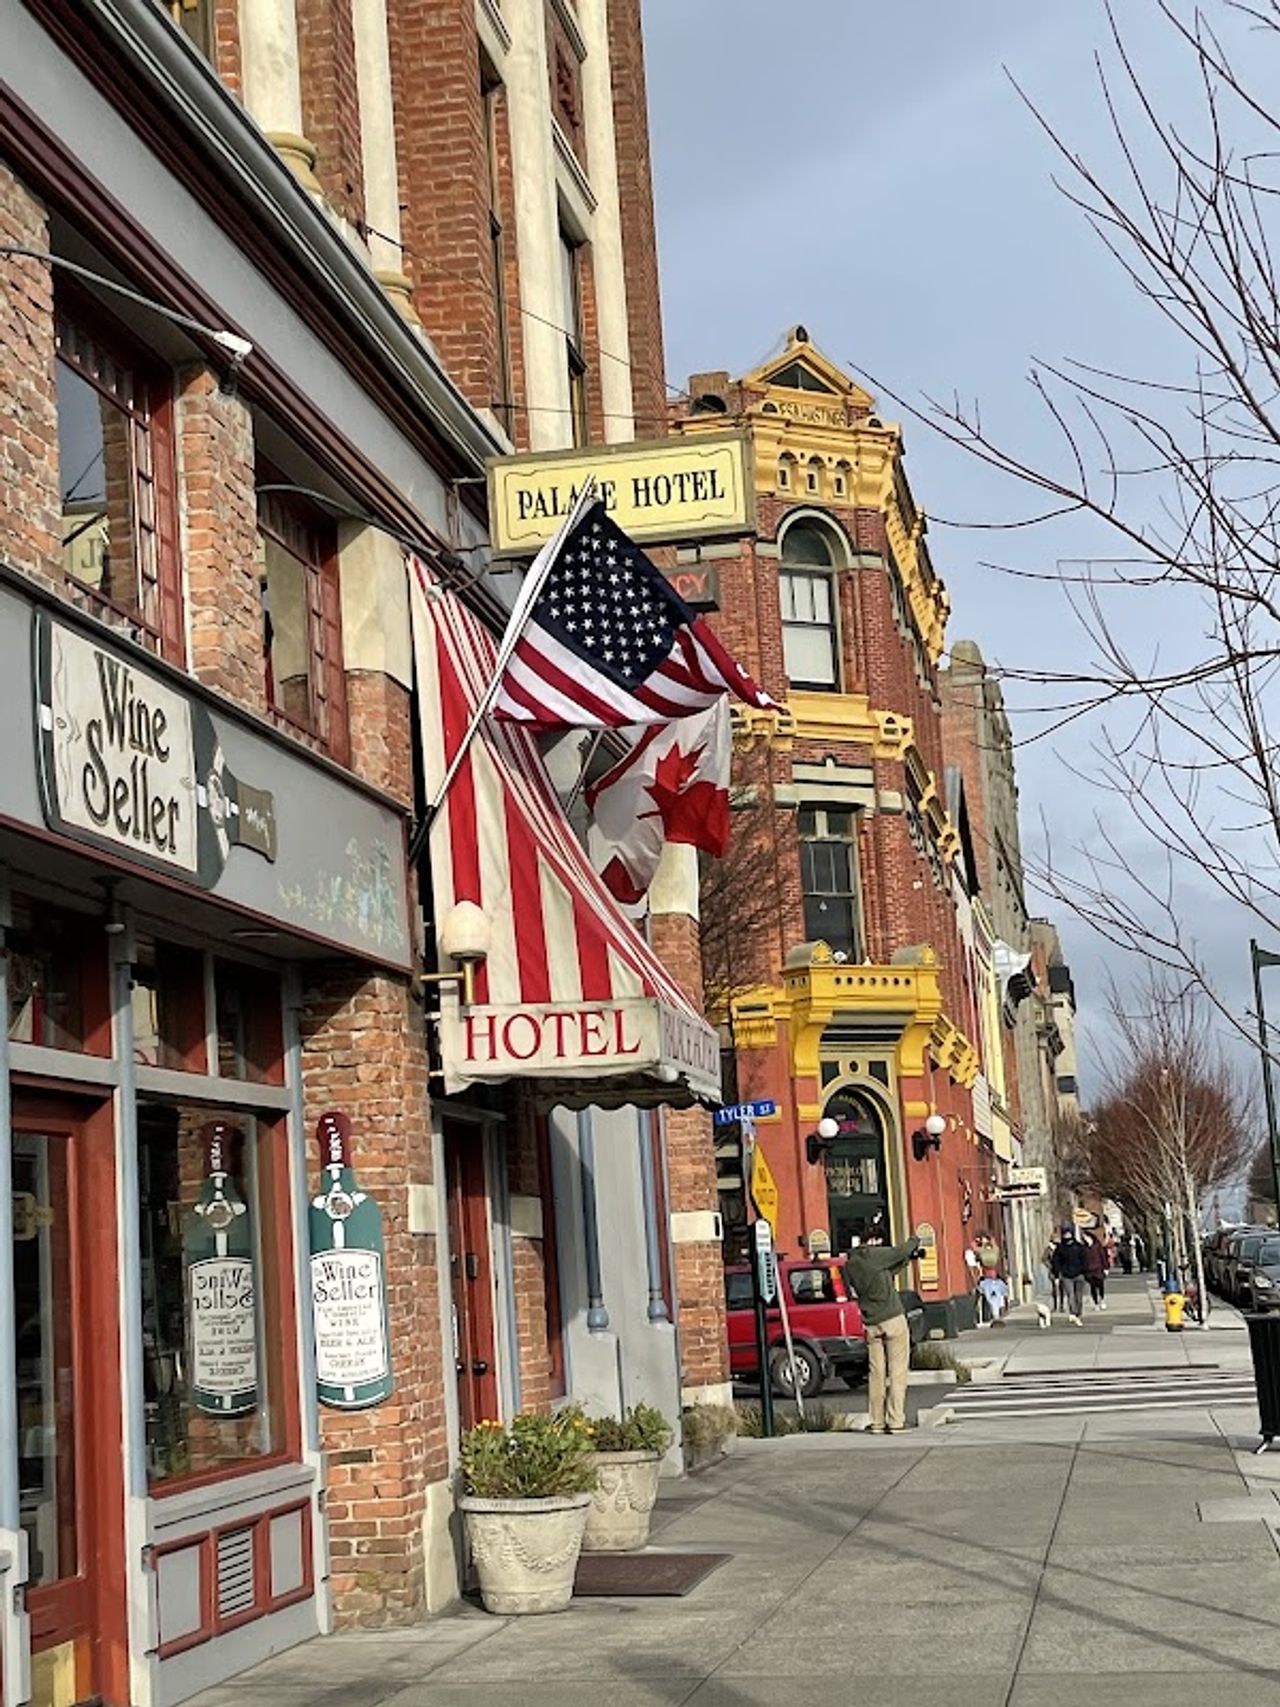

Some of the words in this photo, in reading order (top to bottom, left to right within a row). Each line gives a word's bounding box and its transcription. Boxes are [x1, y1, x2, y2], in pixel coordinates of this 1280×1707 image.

[517, 480, 617, 520] PALAE
[632, 469, 725, 508] HOTEL
[94, 649, 170, 763] Wine
[82, 718, 180, 854] Seller
[464, 1009, 642, 1061] HOTEL
[719, 1104, 754, 1122] TYLER
[313, 1280, 376, 1303] Seller
[320, 1261, 372, 1282] Wine
